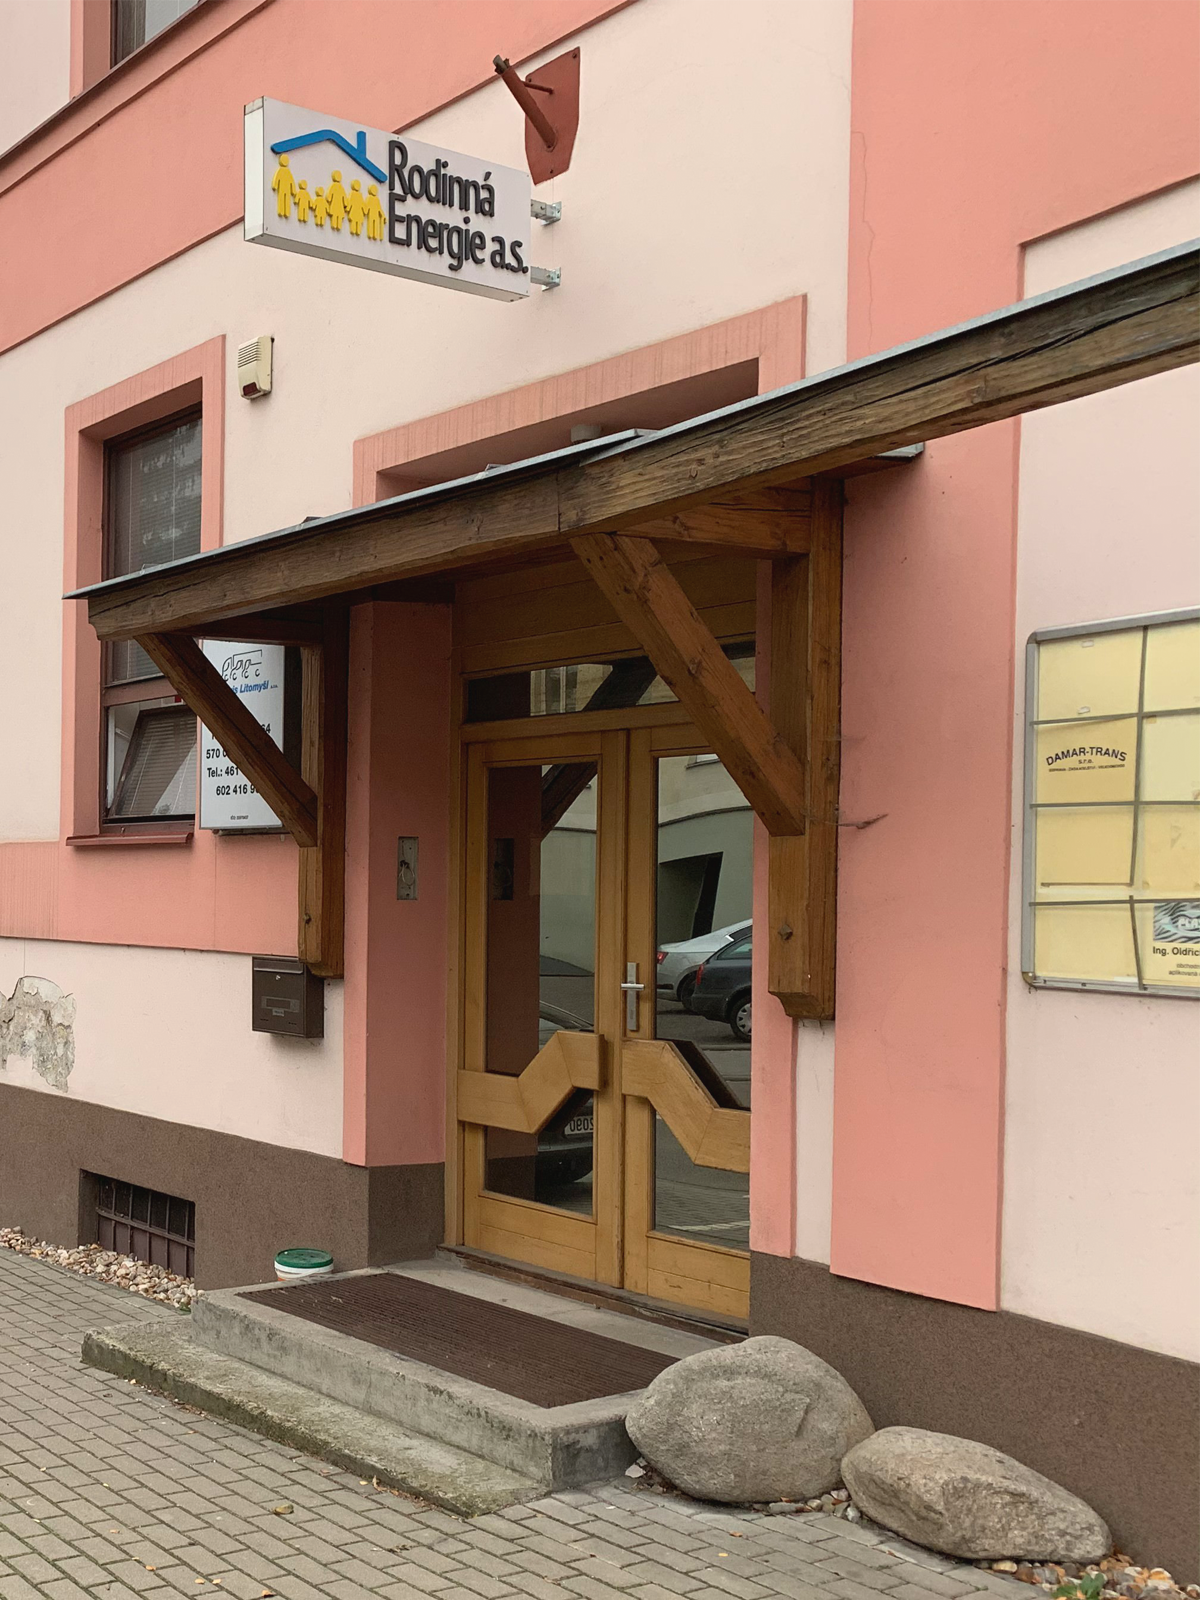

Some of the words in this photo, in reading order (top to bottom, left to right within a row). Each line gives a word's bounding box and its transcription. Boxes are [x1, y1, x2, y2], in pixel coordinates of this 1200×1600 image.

[388, 140, 495, 217] Rodinná
[388, 192, 486, 271] Energie
[490, 236, 529, 274] a.s.
[240, 680, 270, 693] Litomyšl
[206, 748, 220, 759] 570
[1046, 746, 1127, 766] DAMAR-TRANS
[207, 767, 223, 777] Tel.:
[224, 765, 239, 776] 461
[215, 785, 230, 796] 602
[232, 784, 248, 795] 416
[1153, 946, 1169, 957] Ing.
[1172, 946, 1200, 956] Oldřic
